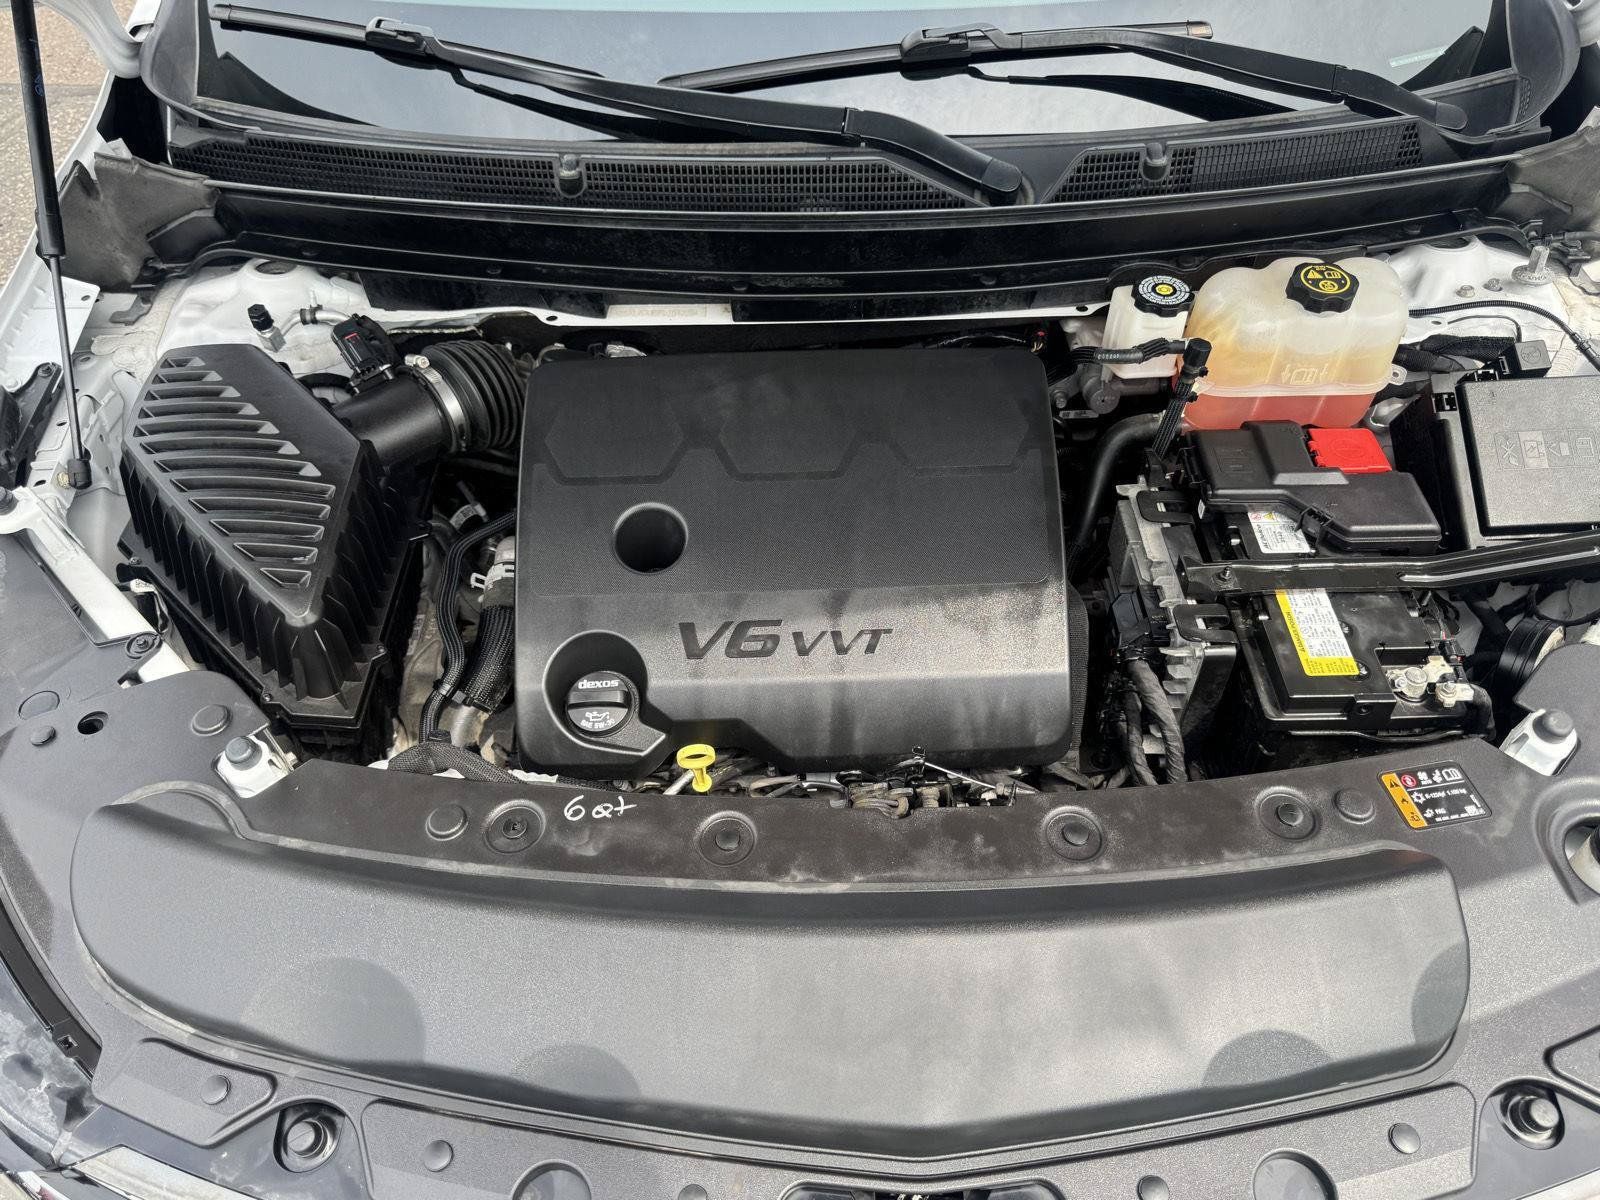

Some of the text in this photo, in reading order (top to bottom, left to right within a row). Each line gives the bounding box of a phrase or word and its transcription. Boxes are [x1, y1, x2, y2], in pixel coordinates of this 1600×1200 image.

[678, 619, 893, 660] V6 VVT
[577, 679, 620, 690] dexos
[580, 718, 616, 729] SAE 5W-30
[563, 794, 586, 821] 6
